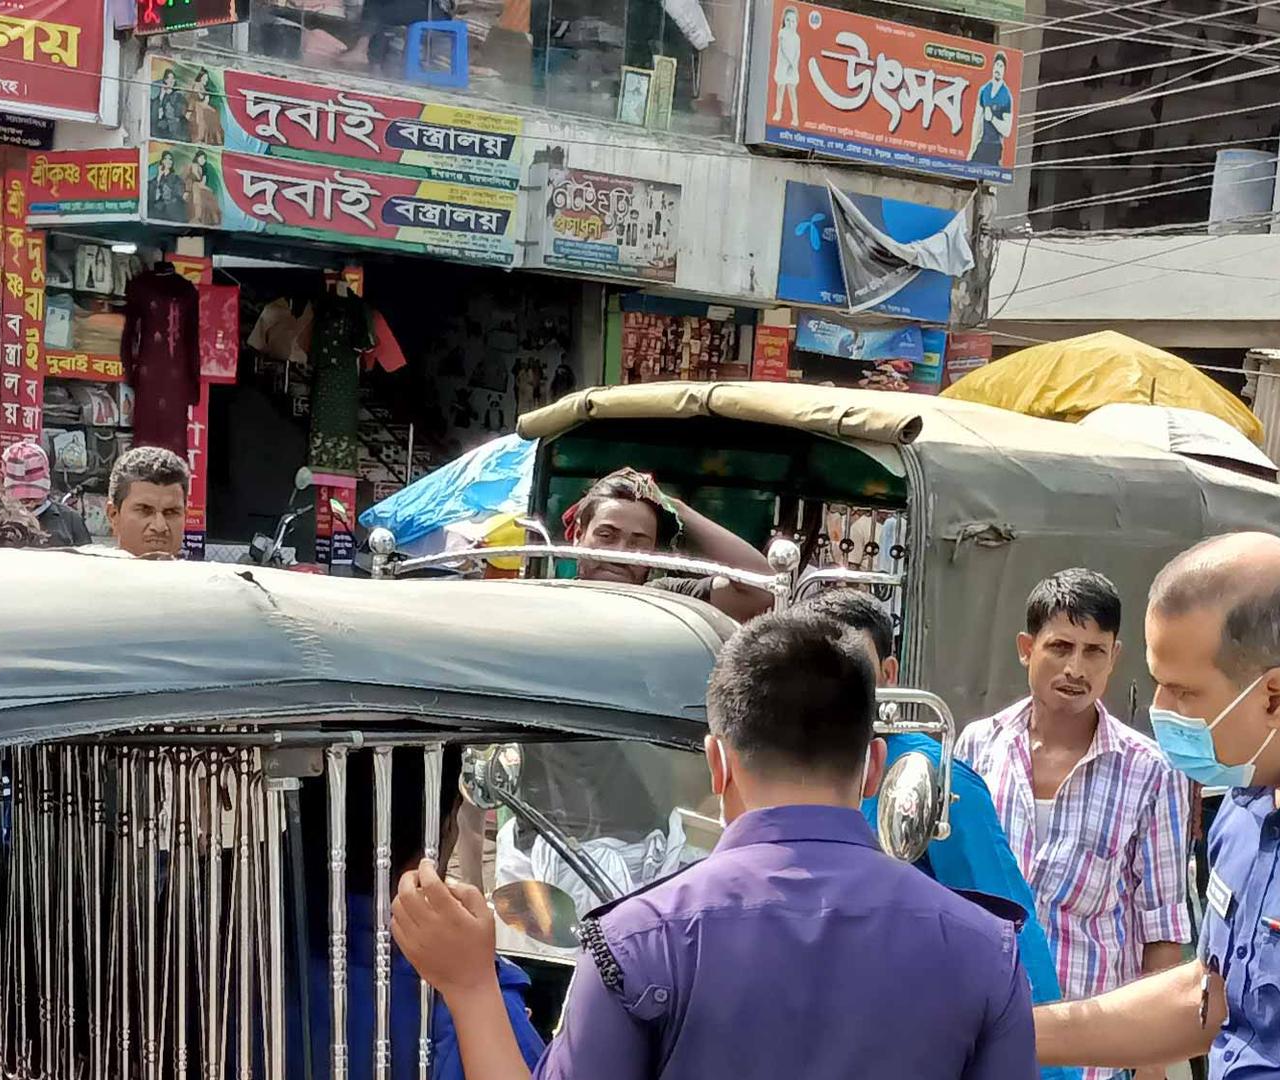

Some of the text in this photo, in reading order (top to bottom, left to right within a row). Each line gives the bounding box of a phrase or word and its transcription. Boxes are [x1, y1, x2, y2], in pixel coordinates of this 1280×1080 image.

[808, 30, 970, 137] উৎসব
[237, 94, 387, 154] দুবাই
[396, 121, 508, 158] বস্ত্রালয়
[31, 155, 138, 197] শ্রীকৃষ্ণ বস্ত্রালয়
[233, 169, 382, 231] দুবাই
[392, 198, 503, 233] বস্ত্রালয়
[45, 353, 88, 376] দুবাই
